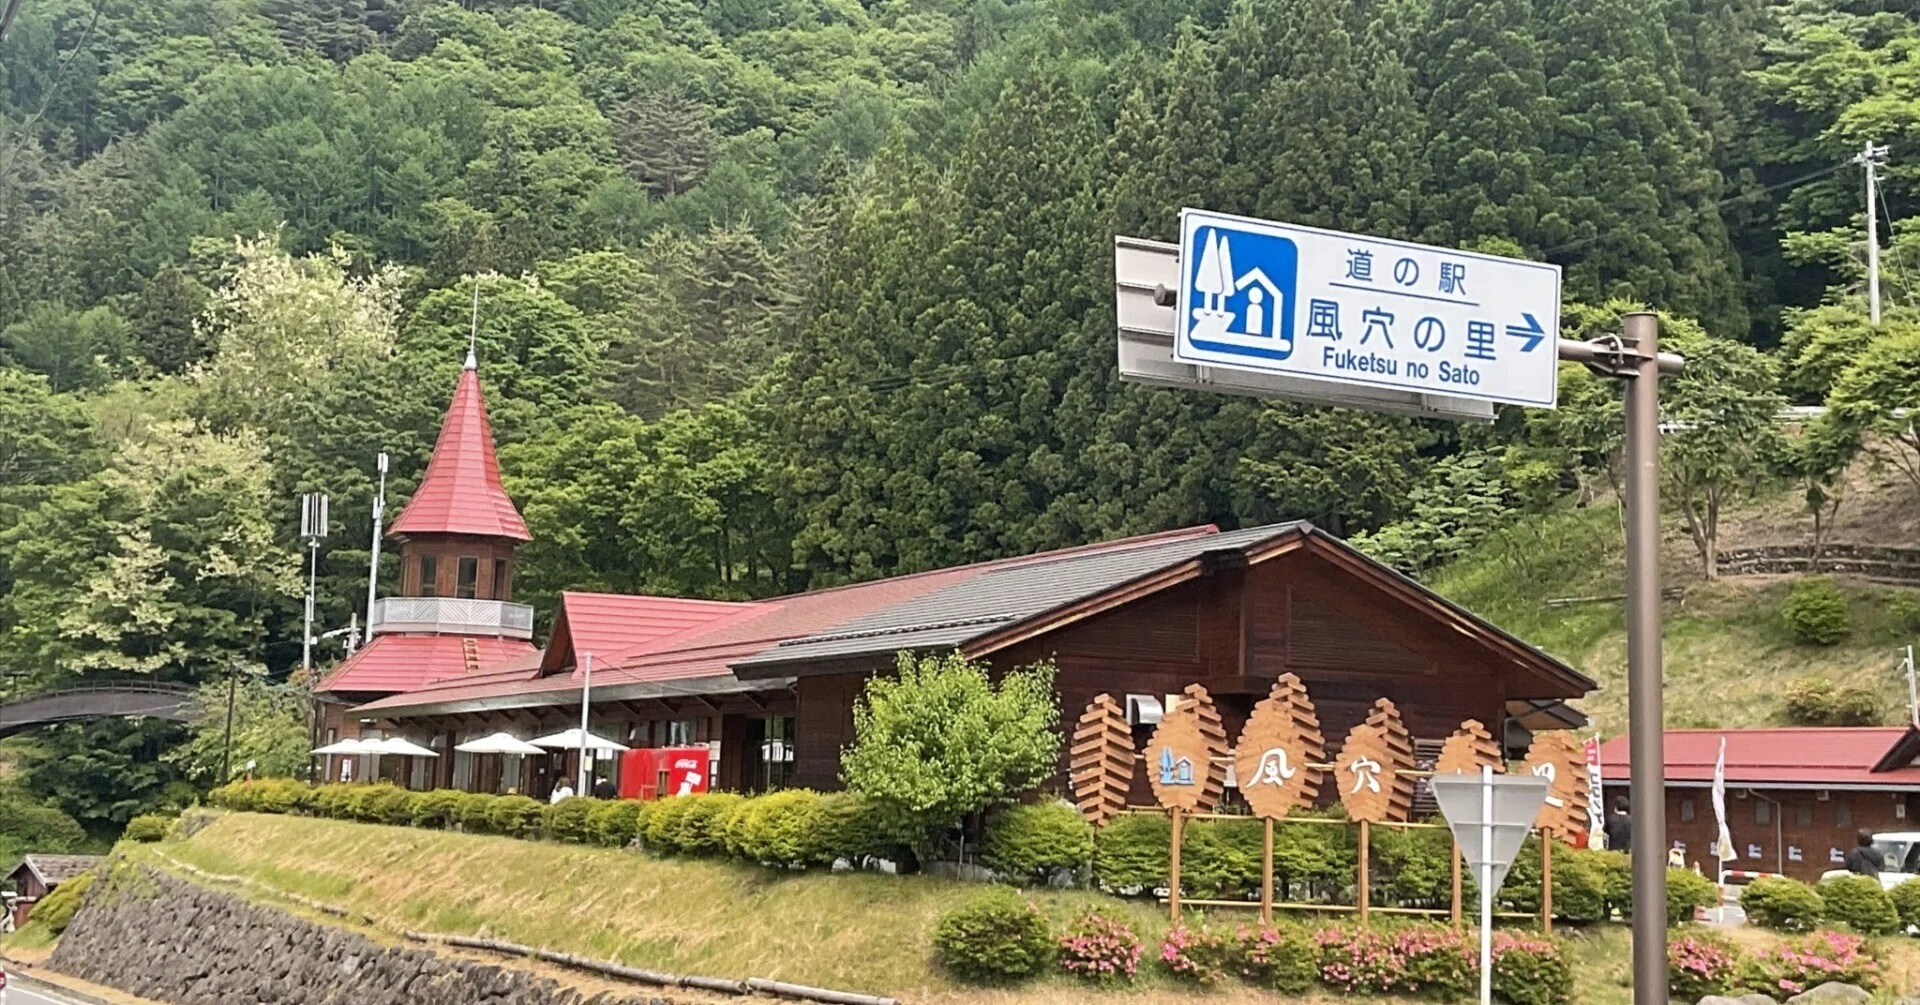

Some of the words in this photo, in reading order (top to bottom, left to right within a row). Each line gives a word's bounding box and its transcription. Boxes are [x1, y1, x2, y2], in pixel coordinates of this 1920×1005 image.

[1345, 248, 1467, 296] 道の駅
[1306, 298, 1497, 361] 風穴の里
[1322, 345, 1398, 376] Fuketsu
[1406, 361, 1429, 379] no
[1438, 360, 1481, 386] Sato
